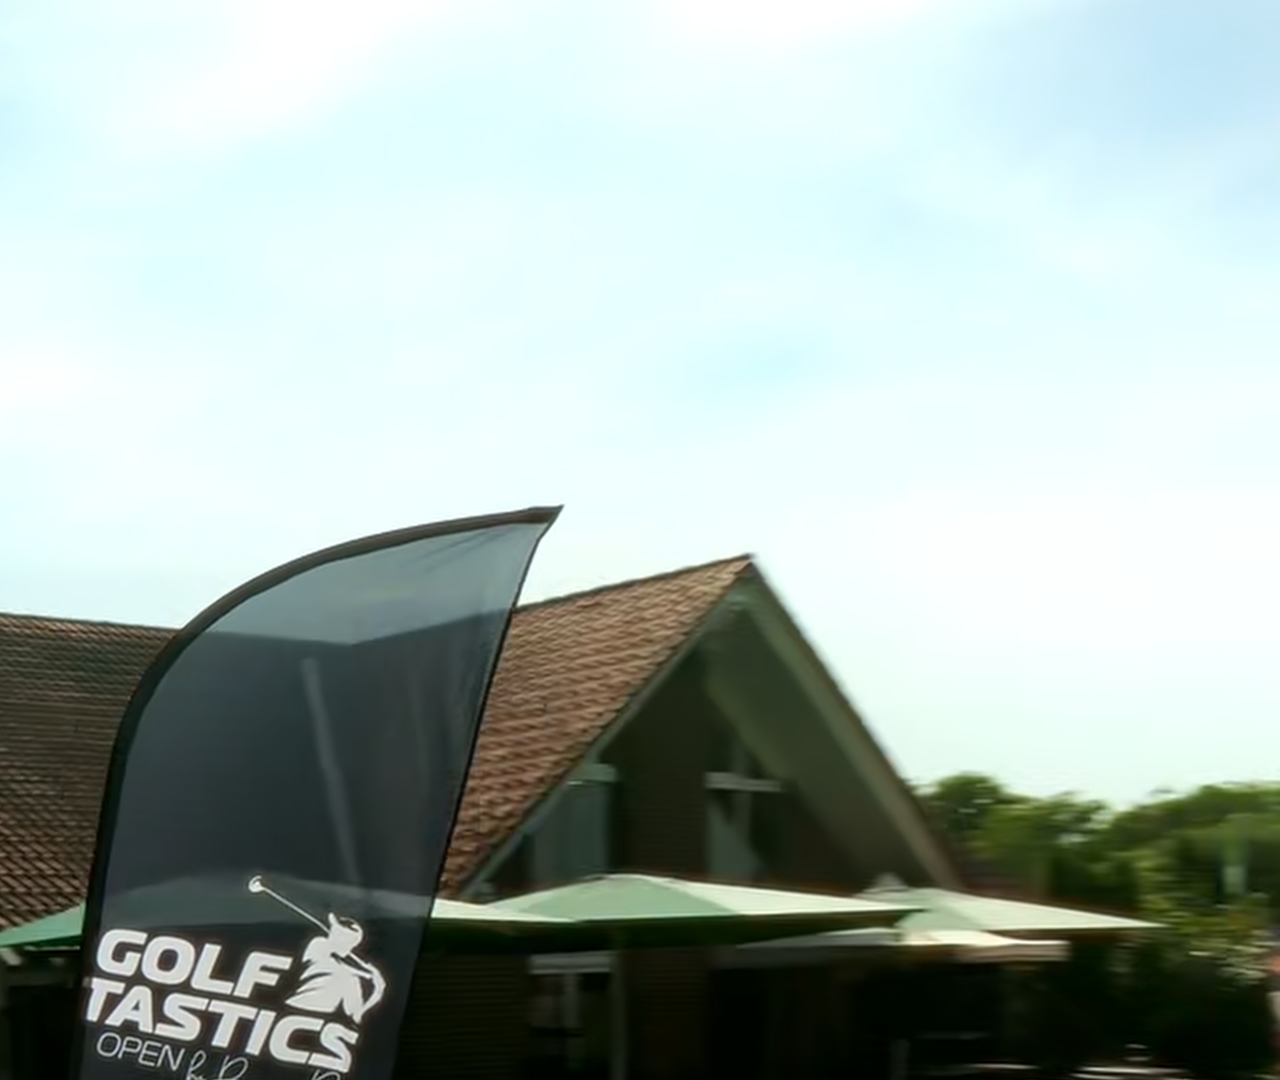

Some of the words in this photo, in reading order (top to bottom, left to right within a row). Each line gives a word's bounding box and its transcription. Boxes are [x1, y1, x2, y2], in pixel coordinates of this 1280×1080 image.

[96, 928, 293, 998] GOLF
[85, 977, 359, 1074] TASTICS
[96, 1032, 186, 1071] OPEN
